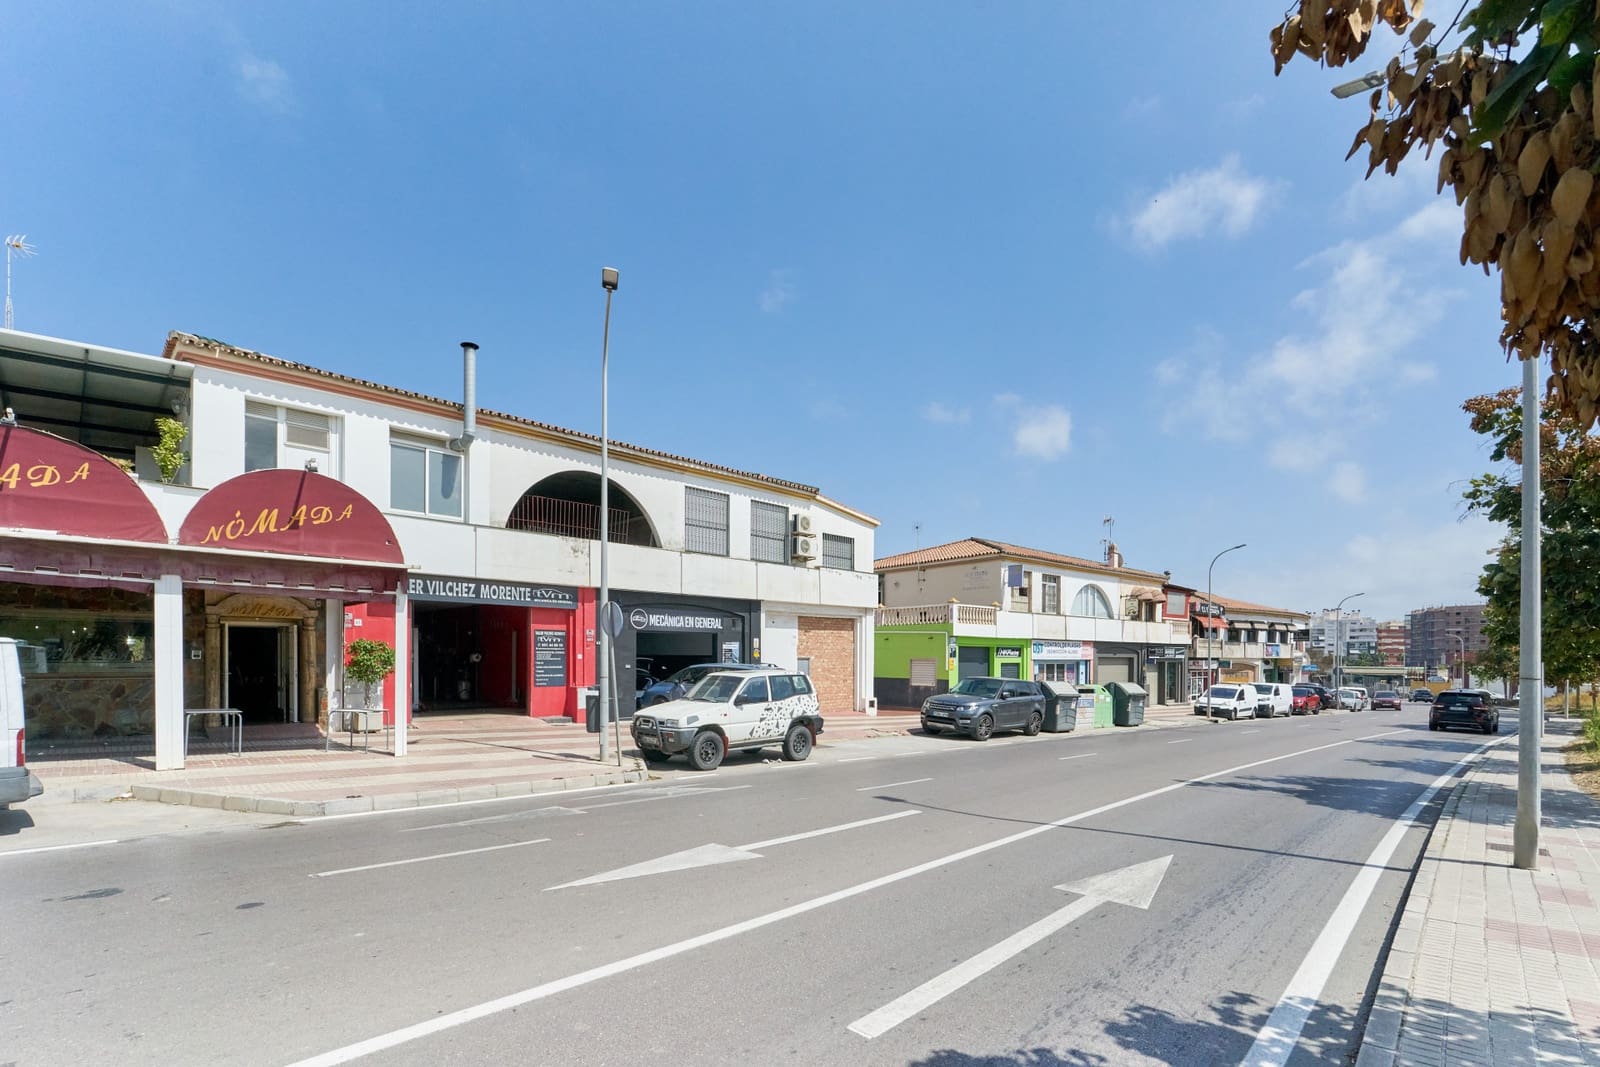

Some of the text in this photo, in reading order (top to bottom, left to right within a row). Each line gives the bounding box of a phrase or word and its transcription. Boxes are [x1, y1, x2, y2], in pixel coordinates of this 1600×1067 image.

[407, 579, 531, 602] ER VILCHEZ MORENTE
[649, 613, 684, 627] MECÁNICA
[685, 616, 694, 628] EN
[695, 617, 723, 630] GENERAL
